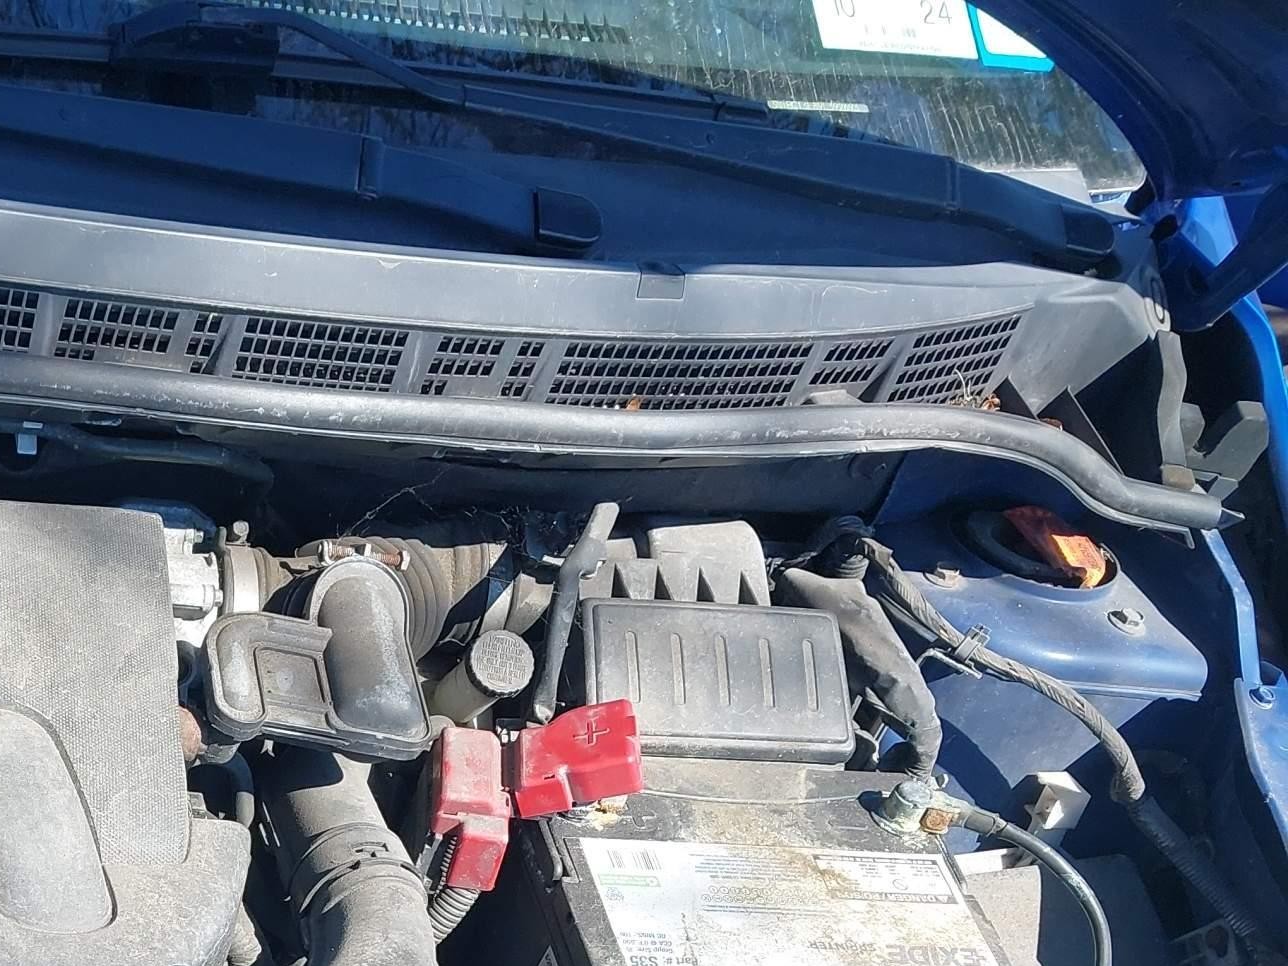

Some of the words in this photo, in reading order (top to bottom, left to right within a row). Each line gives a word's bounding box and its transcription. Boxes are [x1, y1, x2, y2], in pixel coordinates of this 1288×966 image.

[920, 0, 952, 25] 24
[676, 956, 698, 966] Part
[885, 943, 986, 966] EXIDE
